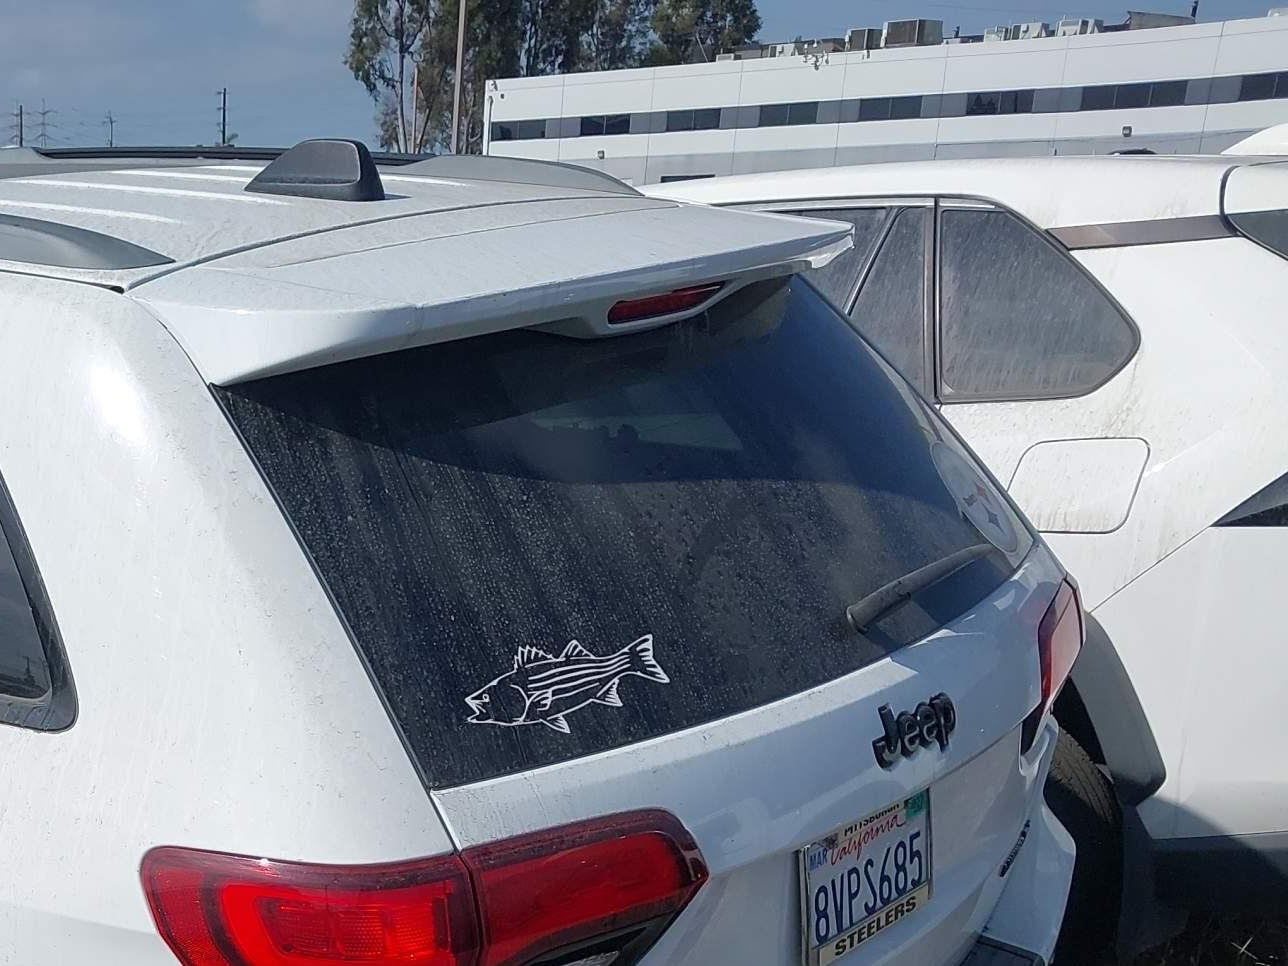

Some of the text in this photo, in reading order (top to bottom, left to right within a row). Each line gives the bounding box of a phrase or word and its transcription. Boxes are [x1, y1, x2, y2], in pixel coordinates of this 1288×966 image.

[872, 692, 955, 770] Jeep
[809, 847, 828, 871] MAR
[830, 813, 906, 866] California
[814, 831, 924, 945] 8VPS685
[834, 896, 917, 956] STEELERS
